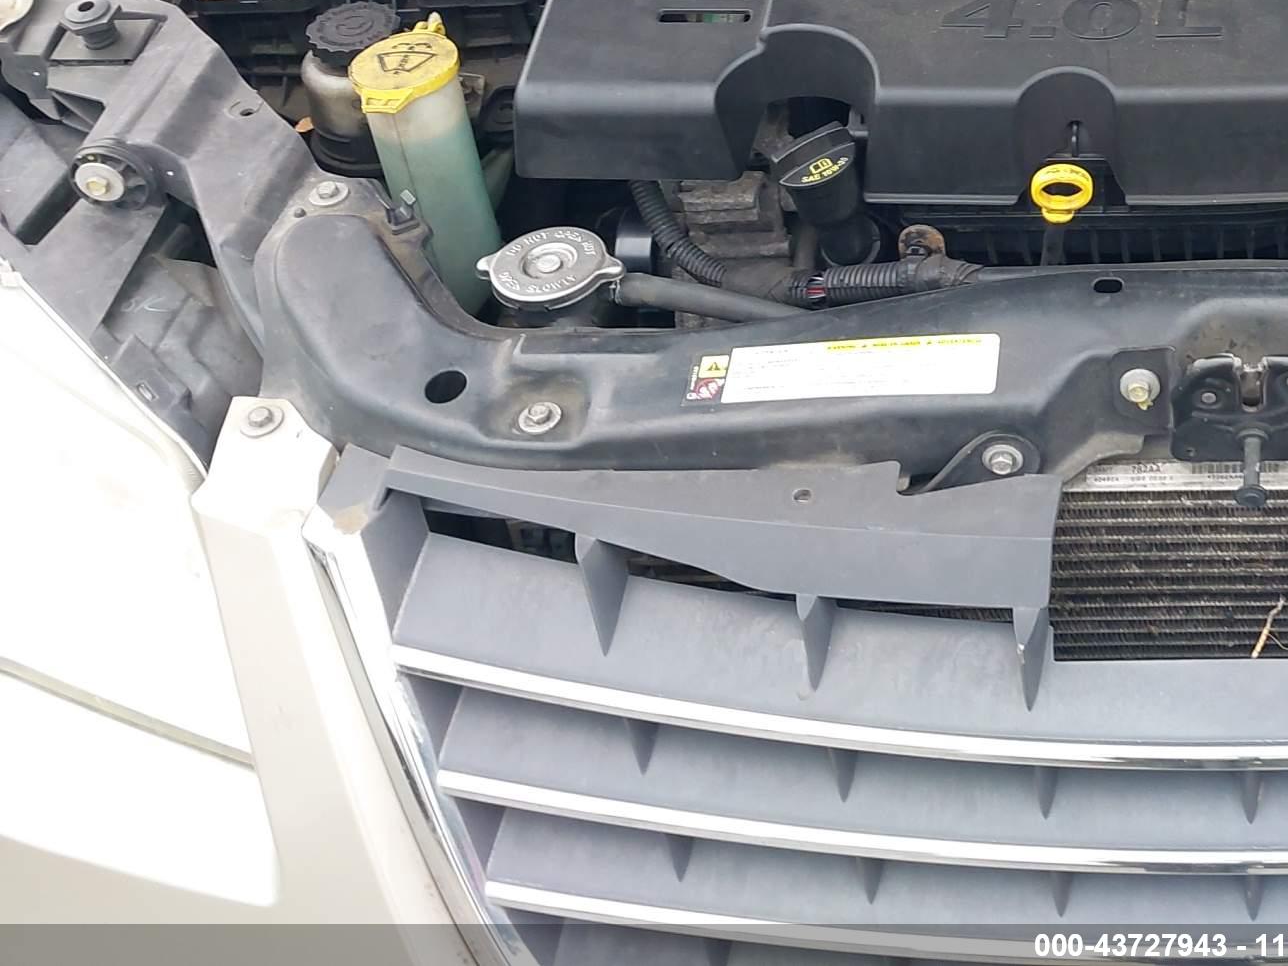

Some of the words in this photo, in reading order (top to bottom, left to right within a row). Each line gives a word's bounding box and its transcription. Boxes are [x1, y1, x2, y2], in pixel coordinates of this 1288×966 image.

[801, 173, 820, 183] SAE
[523, 232, 549, 246] NOT
[525, 274, 577, 293] SLOWLY
